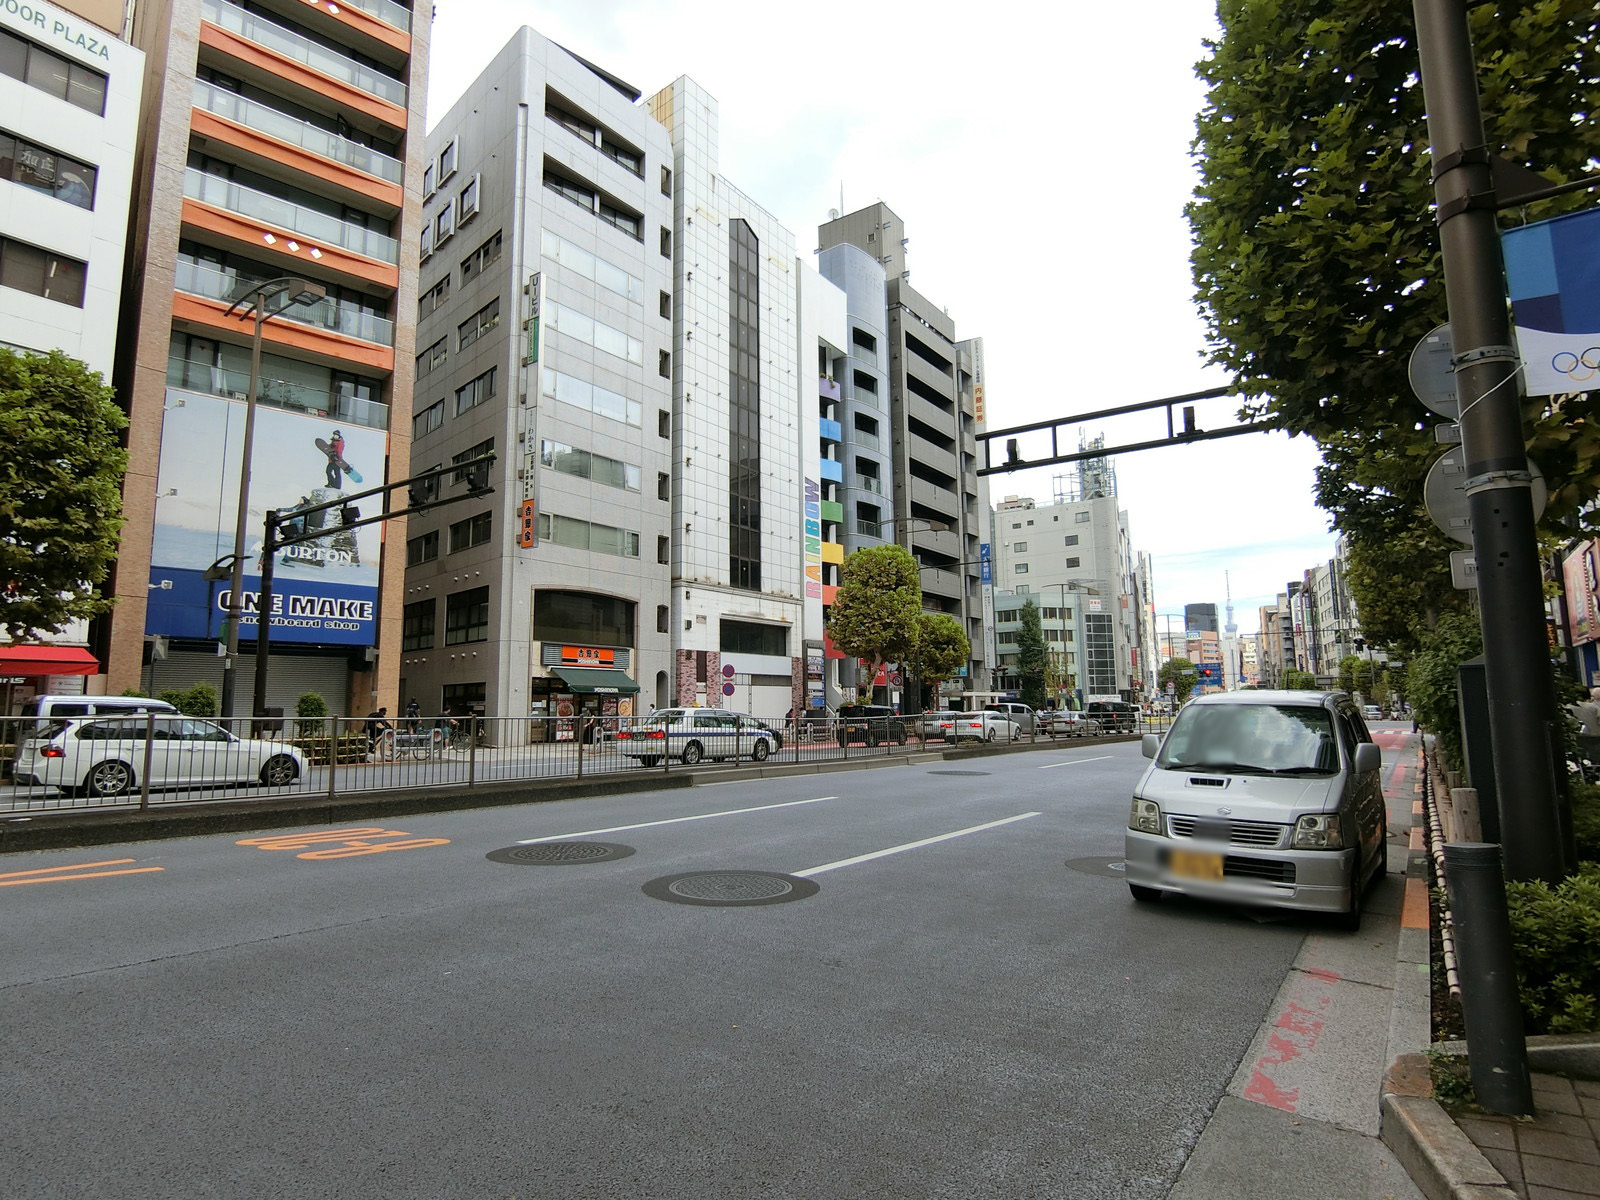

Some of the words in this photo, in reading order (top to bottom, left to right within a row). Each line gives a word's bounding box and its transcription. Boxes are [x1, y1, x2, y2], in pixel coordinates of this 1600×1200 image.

[0, 0, 46, 29] OOR
[53, 21, 109, 61] PLAZA
[805, 477, 821, 599] RAINBOW
[289, 595, 373, 621] MAKE
[324, 620, 360, 631] shop
